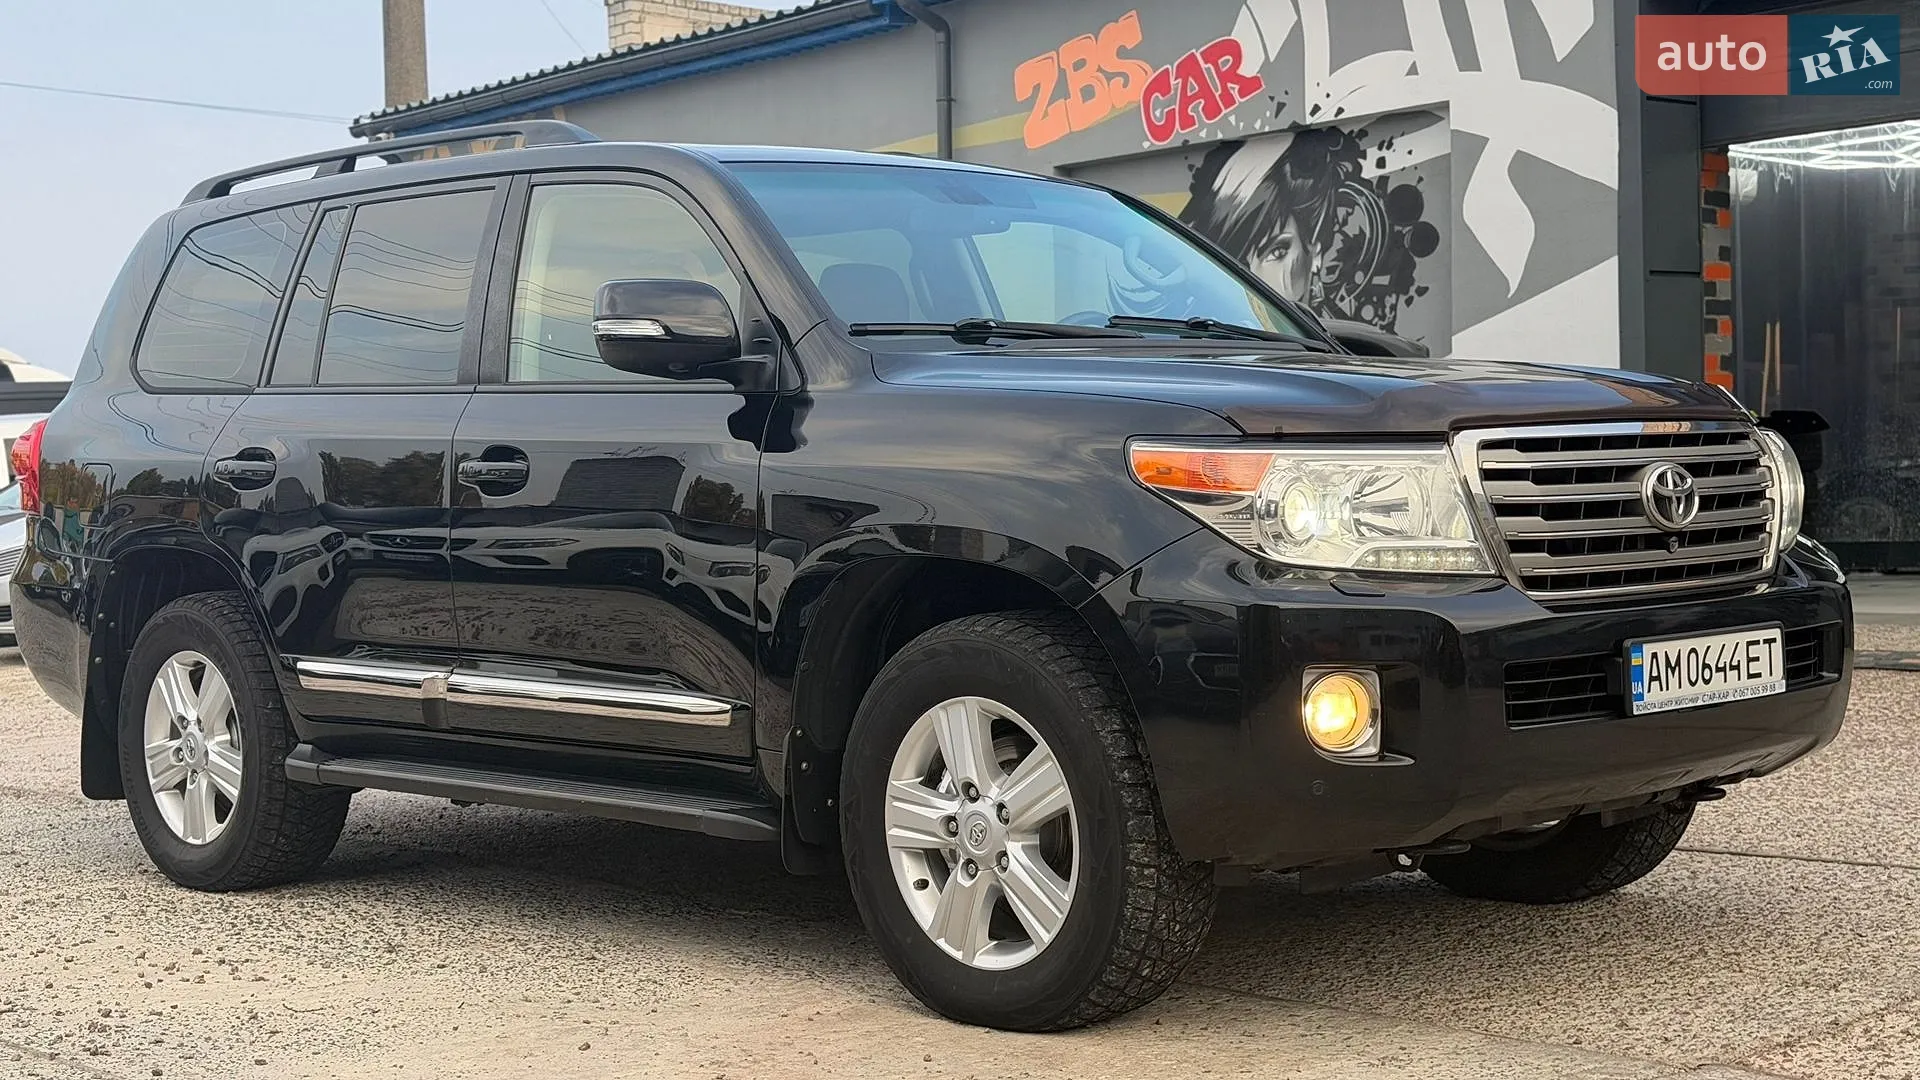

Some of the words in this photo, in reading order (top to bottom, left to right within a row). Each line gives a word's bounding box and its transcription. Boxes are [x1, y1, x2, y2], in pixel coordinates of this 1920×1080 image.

[1014, 9, 1153, 149] ZBS
[1140, 36, 1265, 145] CAR
[1631, 681, 1643, 695] UA
[1701, 691, 1730, 703] СТАР-КАР
